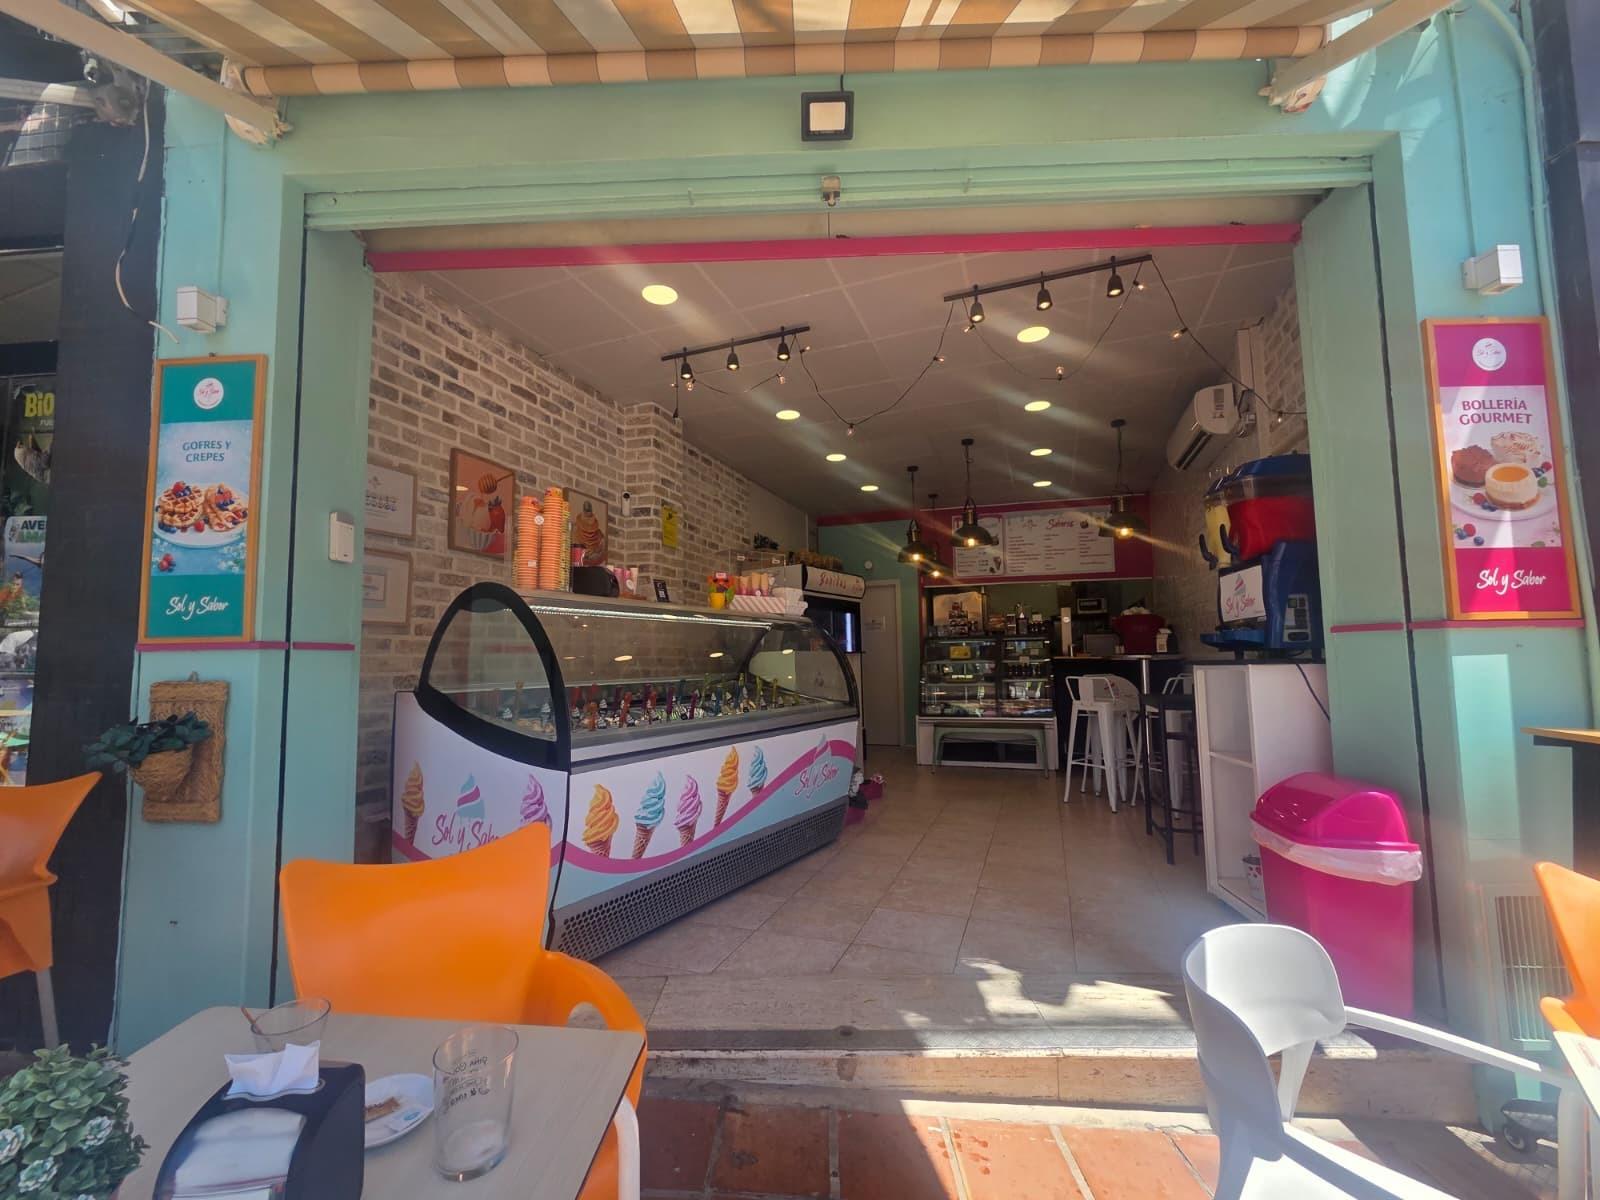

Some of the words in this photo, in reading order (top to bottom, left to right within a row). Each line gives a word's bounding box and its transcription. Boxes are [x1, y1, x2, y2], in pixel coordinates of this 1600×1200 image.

[1462, 397, 1528, 412] BOLLERÍA
[1459, 412, 1533, 426] GOURMET
[182, 440, 222, 451] GOFRES
[225, 440, 232, 450] Y
[185, 452, 225, 462] CREPES
[1476, 568, 1499, 590] Sol
[1495, 573, 1510, 595] y
[1511, 569, 1547, 590] Sabor
[165, 593, 188, 615] Sol
[181, 600, 196, 621] y
[196, 595, 230, 615] Sabor
[432, 812, 456, 846] Sol
[457, 826, 466, 853] y
